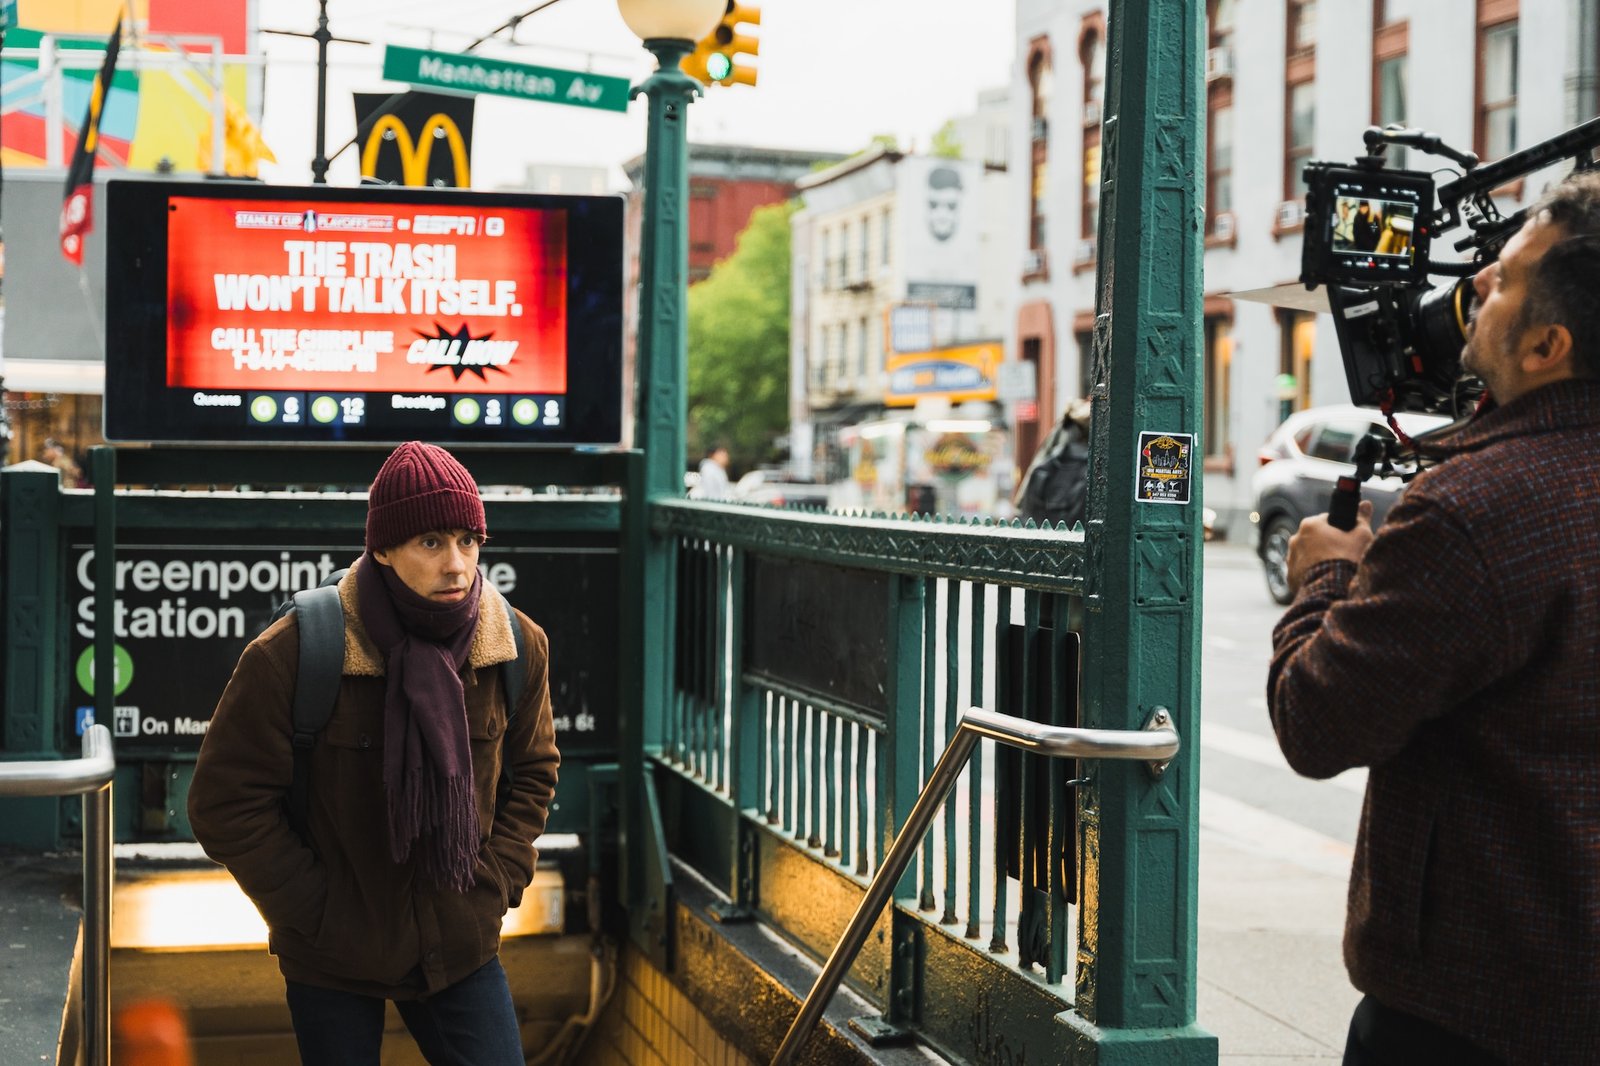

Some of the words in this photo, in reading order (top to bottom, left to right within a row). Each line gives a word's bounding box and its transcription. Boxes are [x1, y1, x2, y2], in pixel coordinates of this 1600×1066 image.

[417, 55, 556, 96] Manhattan
[566, 77, 603, 102] Av
[236, 213, 280, 226] STANLEY
[281, 214, 302, 226] CUP
[412, 214, 476, 236] ESPN
[284, 240, 347, 278] THE
[349, 242, 457, 280] TRASH
[214, 274, 320, 312] WON'T
[324, 277, 407, 314] TALK
[410, 279, 522, 317] ITSELF.
[211, 328, 259, 351] CALL
[260, 329, 297, 351] THE
[406, 339, 461, 365] CALL
[461, 340, 519, 366] NOW
[341, 397, 365, 416] 12
[486, 399, 501, 417] 3
[76, 596, 245, 639] Station
[142, 716, 169, 735] On
